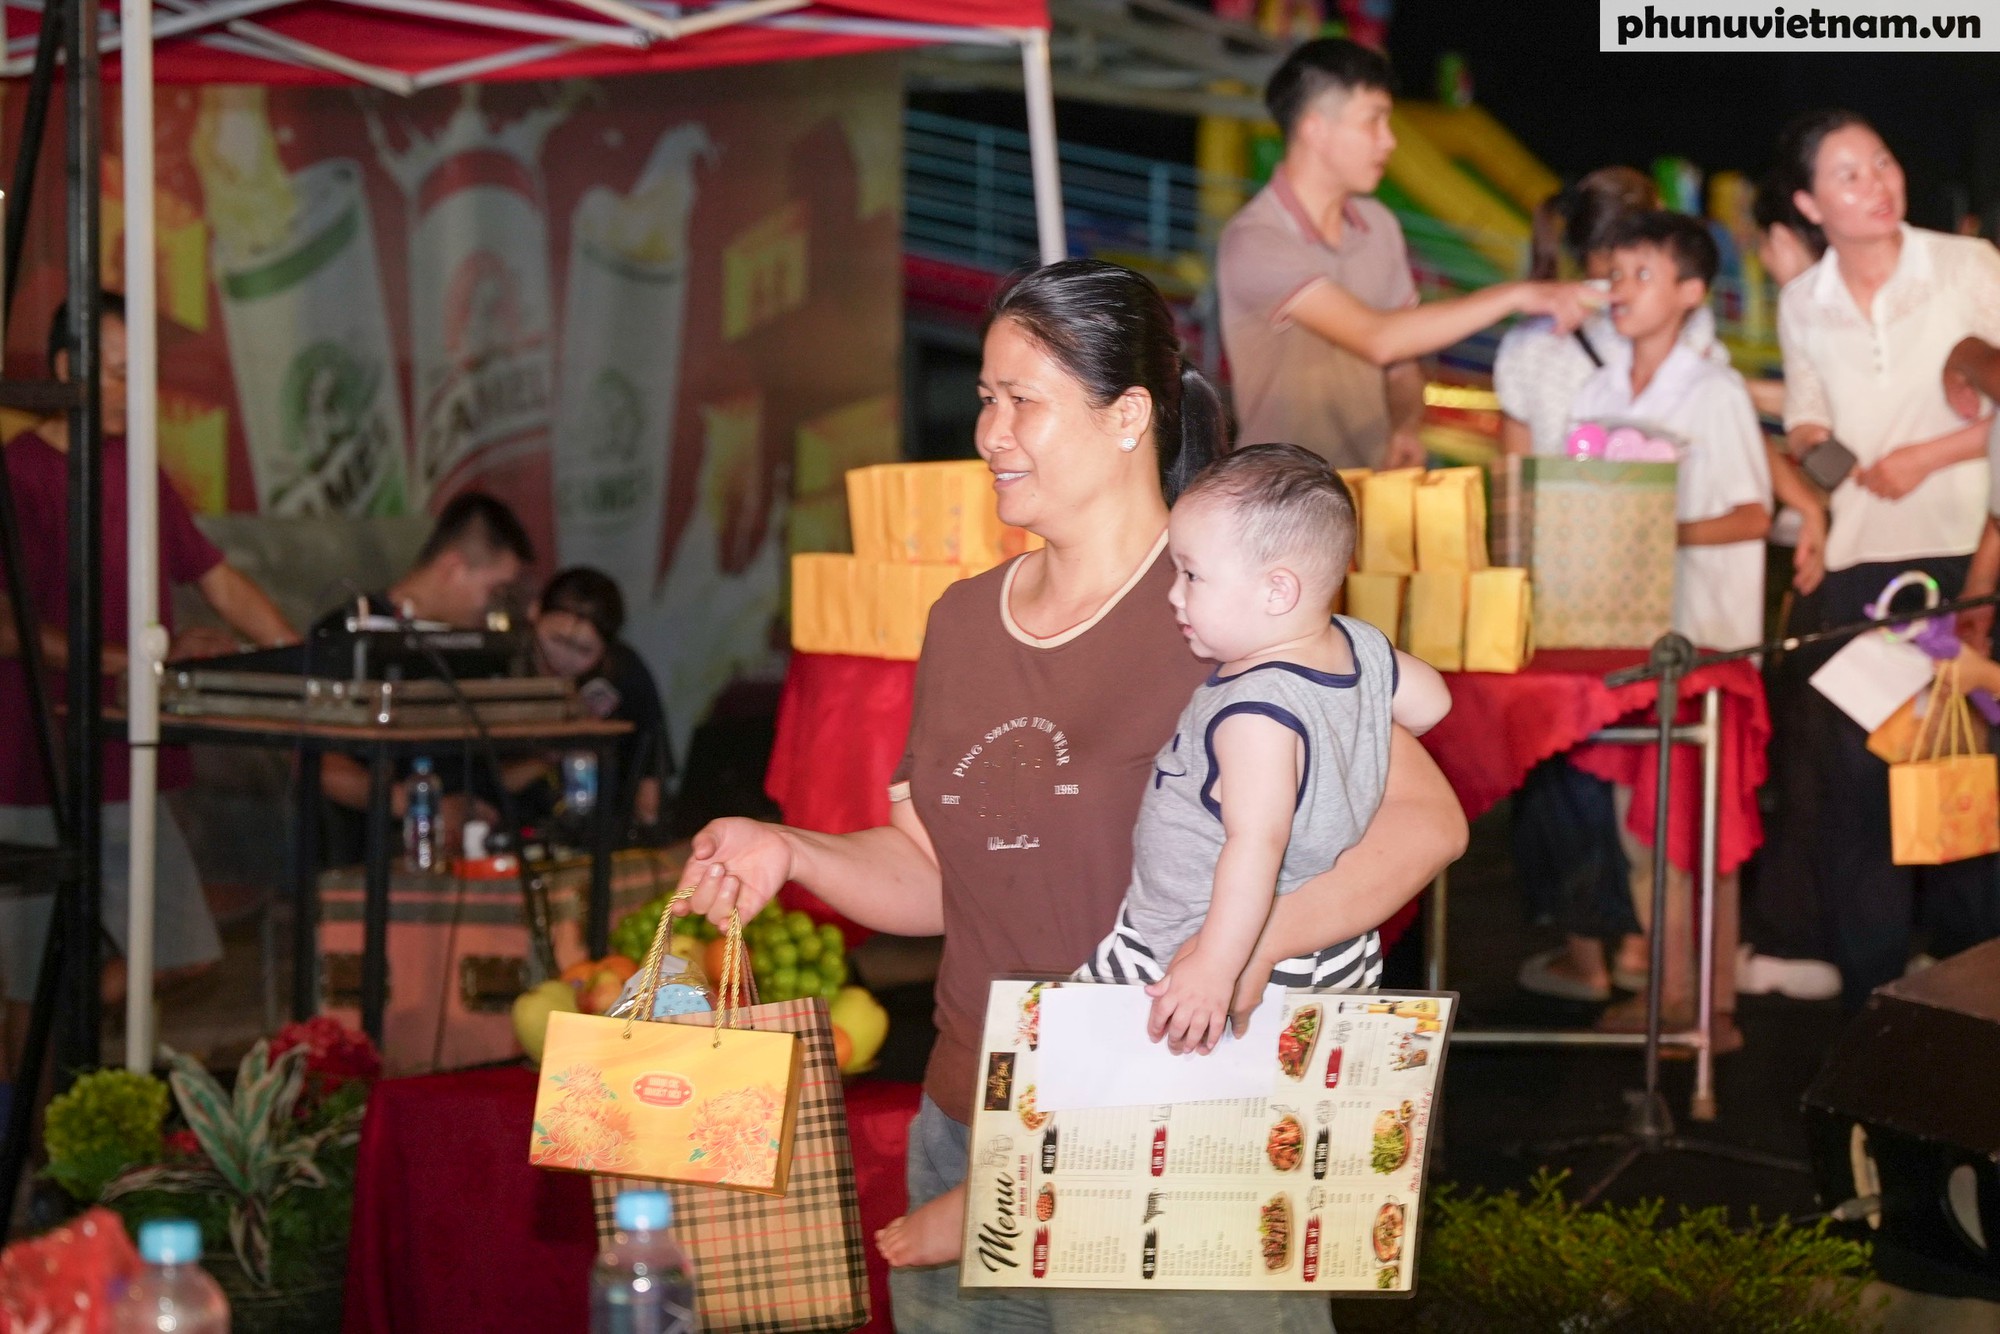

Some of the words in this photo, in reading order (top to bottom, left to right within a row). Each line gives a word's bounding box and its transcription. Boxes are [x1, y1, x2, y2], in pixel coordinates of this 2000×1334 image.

[952, 744, 983, 778] PING
[984, 716, 1028, 743] SHANG
[1031, 716, 1056, 734] YUN
[1051, 730, 1071, 767] WEAR
[941, 795, 960, 805] EST
[978, 1172, 1023, 1273] Menu
